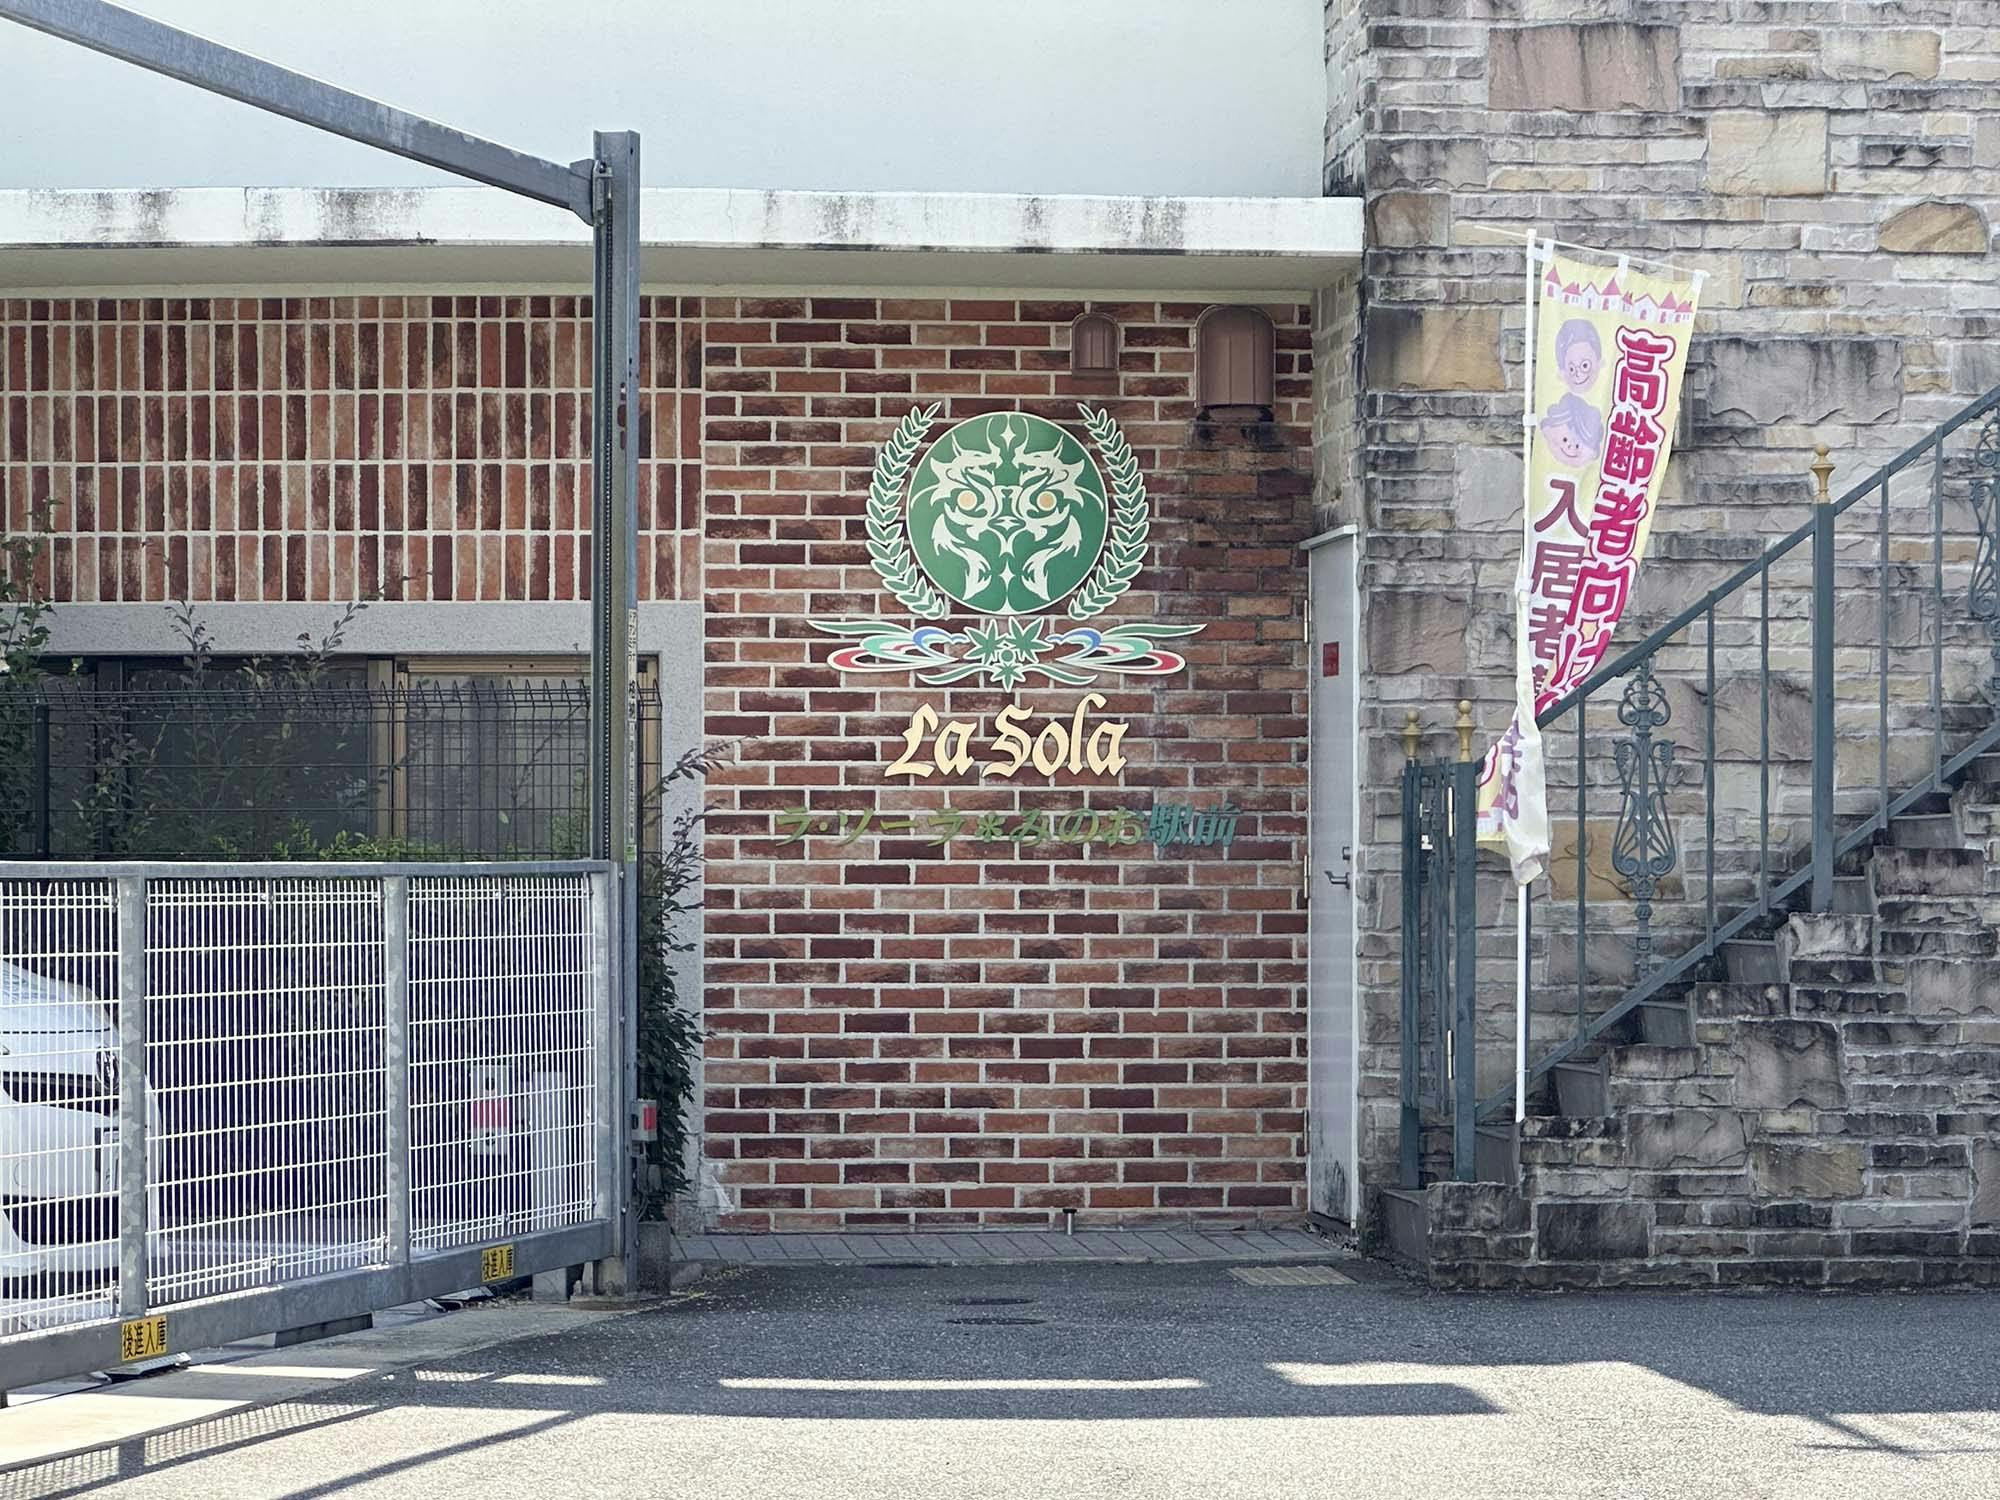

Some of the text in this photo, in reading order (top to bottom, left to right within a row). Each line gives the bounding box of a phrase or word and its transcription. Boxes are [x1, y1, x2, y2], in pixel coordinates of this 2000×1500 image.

[884, 692, 1130, 778] La Sola
[123, 1317, 166, 1359] 後進入庫
